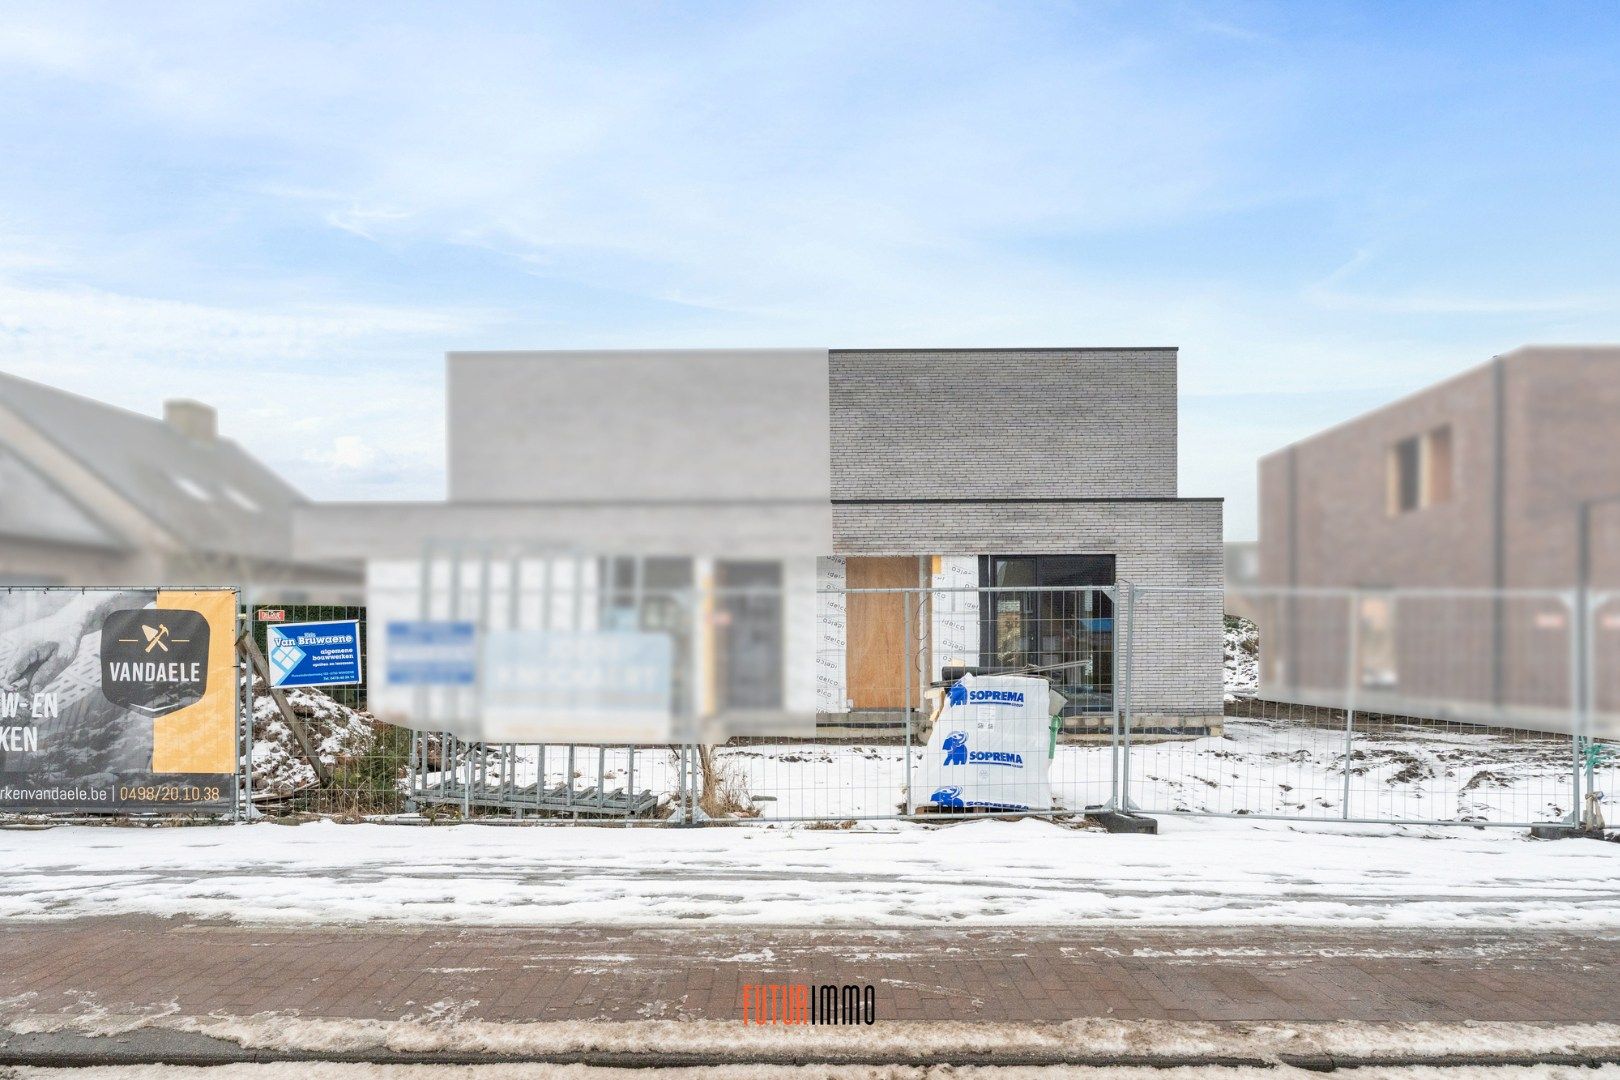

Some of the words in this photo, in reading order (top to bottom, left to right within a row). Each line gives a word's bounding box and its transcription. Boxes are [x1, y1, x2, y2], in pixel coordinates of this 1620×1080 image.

[274, 638, 296, 647] Van
[320, 648, 353, 656] algemene
[109, 661, 200, 682] VANDAELE
[969, 690, 1024, 702] SOPREMA
[31, 692, 58, 718] EN
[0, 726, 38, 751] KEN
[969, 750, 1023, 764] SOPREMA
[0, 786, 107, 800] rkenvandaele.be
[120, 786, 220, 801] 0498/20.10.38
